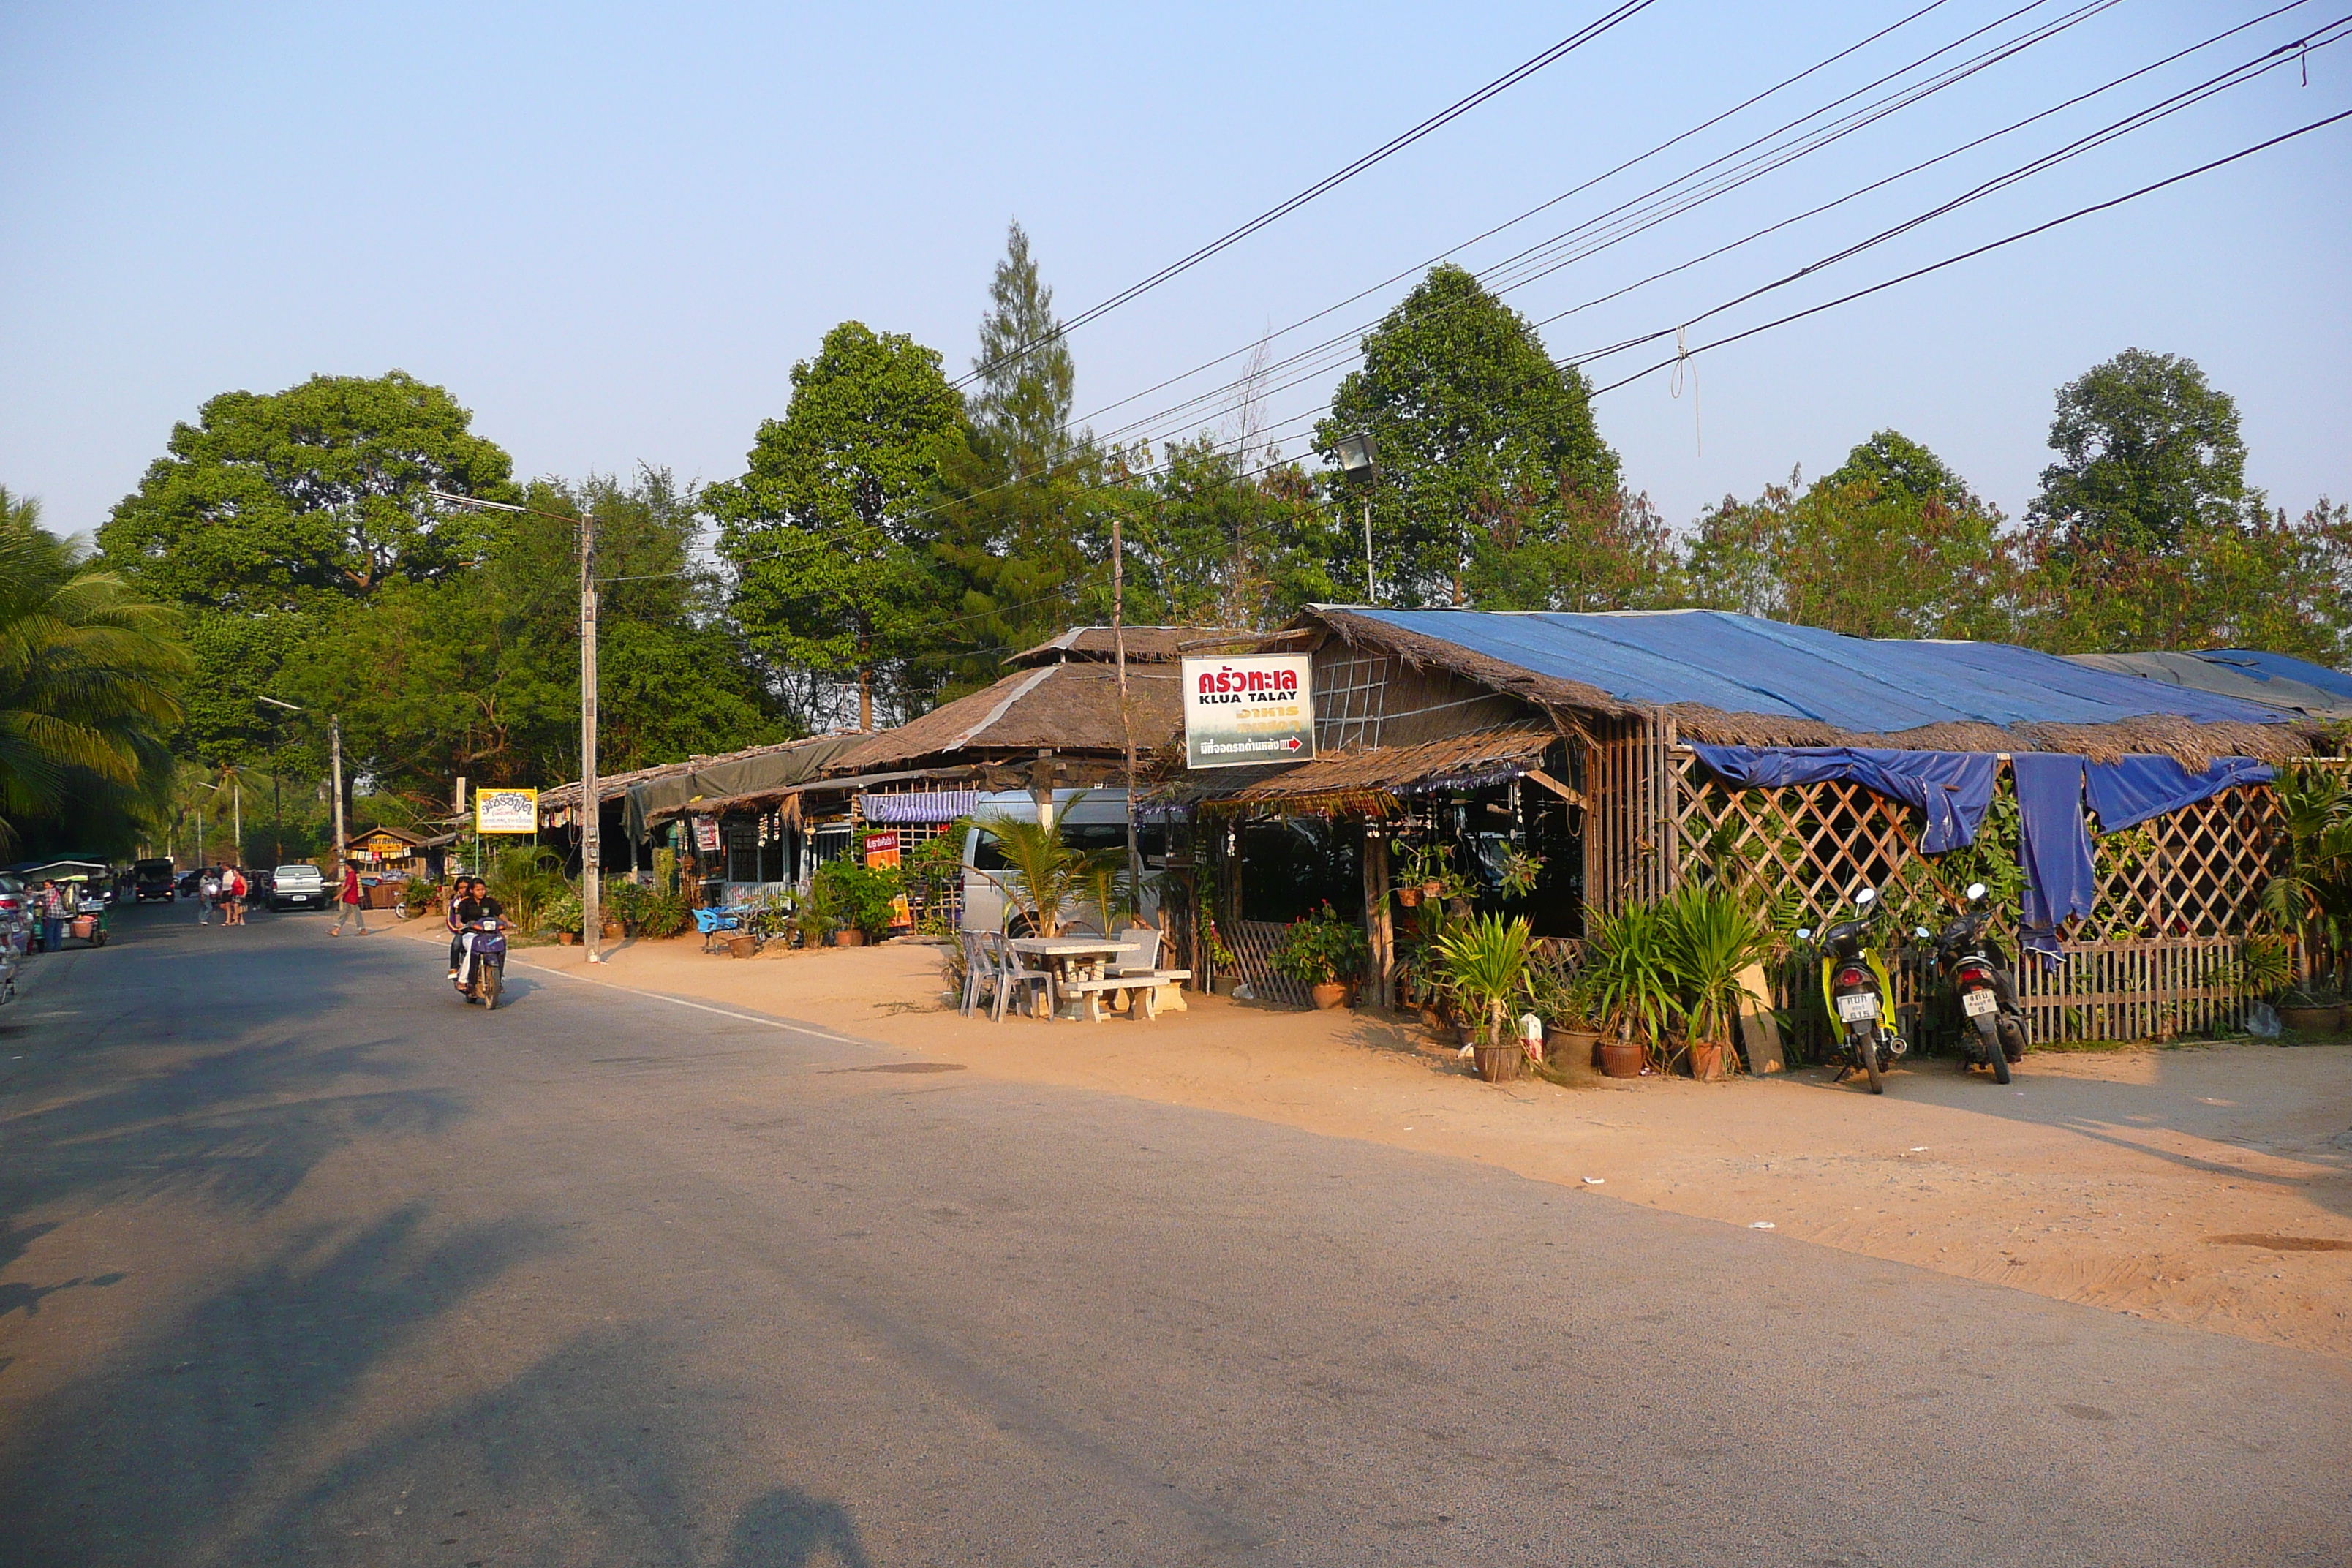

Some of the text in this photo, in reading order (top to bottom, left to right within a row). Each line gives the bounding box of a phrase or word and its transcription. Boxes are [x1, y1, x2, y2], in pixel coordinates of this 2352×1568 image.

[1199, 666, 1297, 694] ครัวทะเล
[1199, 691, 1297, 704] KLUA TALAY
